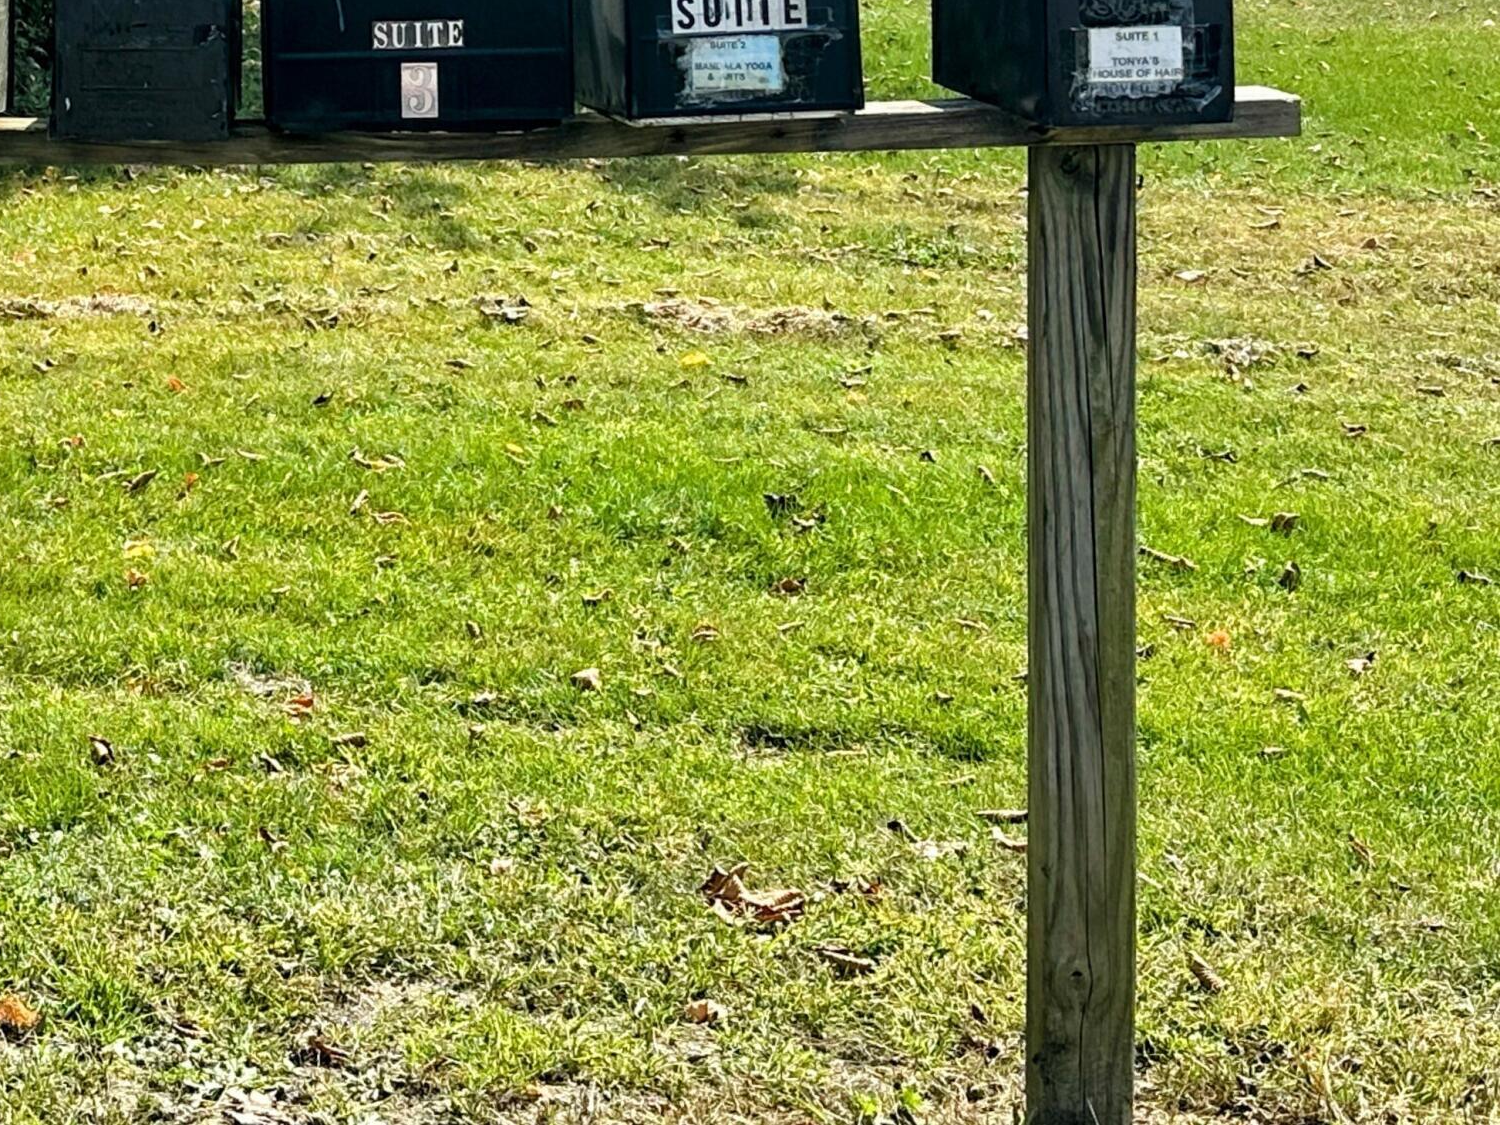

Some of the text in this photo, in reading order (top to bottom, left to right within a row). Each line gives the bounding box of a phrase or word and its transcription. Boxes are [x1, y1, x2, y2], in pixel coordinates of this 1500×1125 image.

[372, 19, 465, 49] SUITE
[1115, 31, 1149, 42] SUITE
[709, 41, 747, 49] SUITE 2
[745, 61, 773, 70] YOGA
[1111, 56, 1160, 66] TONYA'S
[1093, 68, 1133, 78] HOUSE
[1136, 68, 1151, 77] OF
[406, 66, 434, 115] 3
